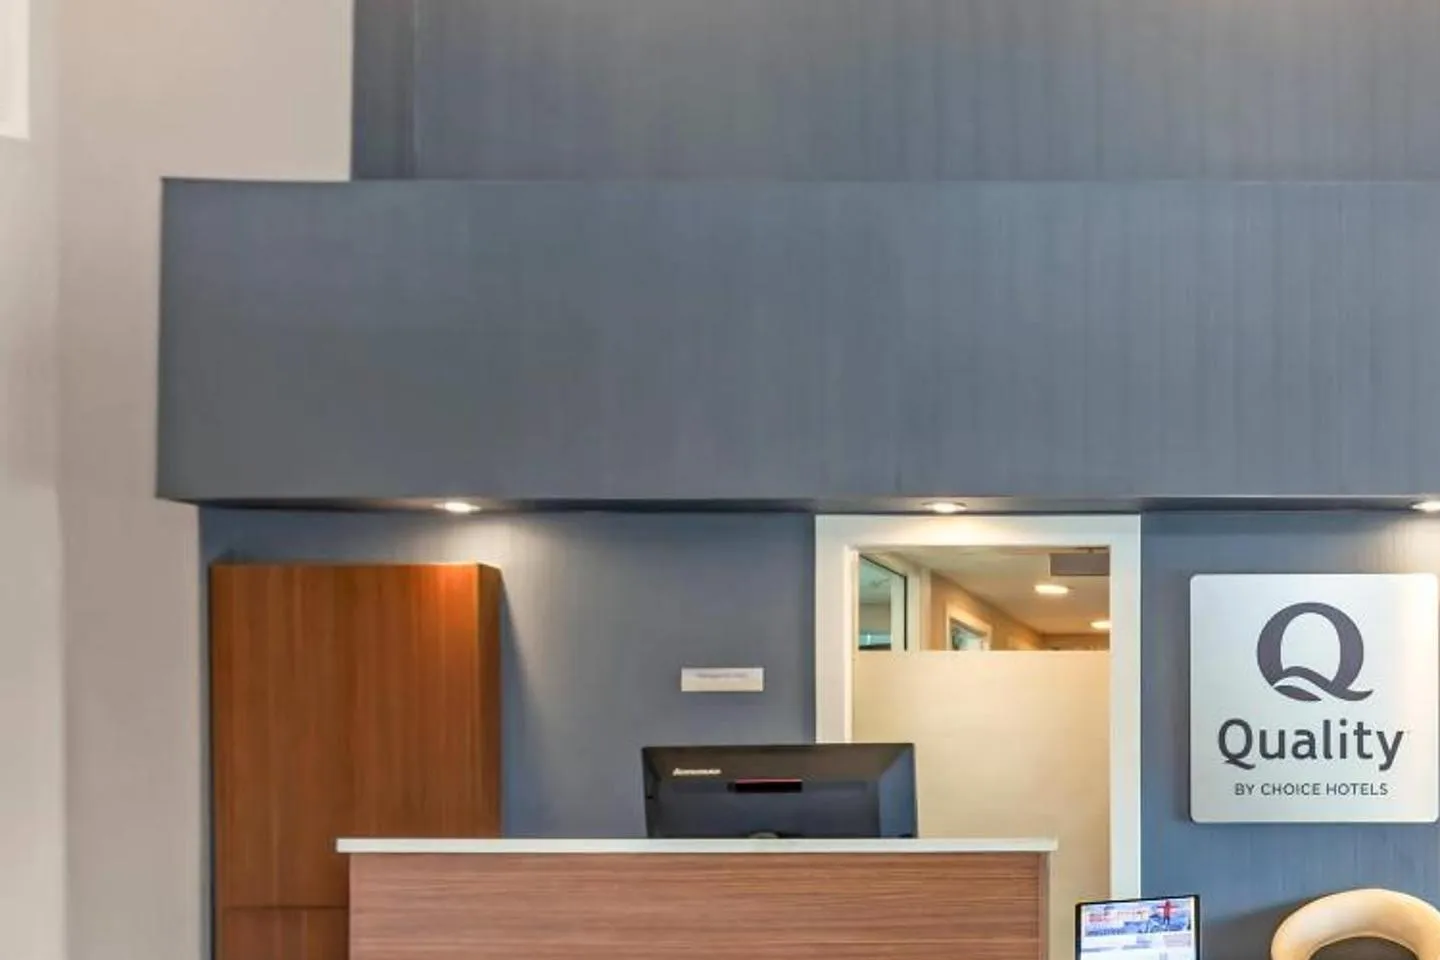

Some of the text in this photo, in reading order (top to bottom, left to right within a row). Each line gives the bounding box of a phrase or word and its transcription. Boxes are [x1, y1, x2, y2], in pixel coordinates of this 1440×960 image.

[1256, 602, 1373, 701] Q
[1218, 719, 1404, 771] Quality
[1234, 783, 1389, 796] BY CHOICE HOTELS
